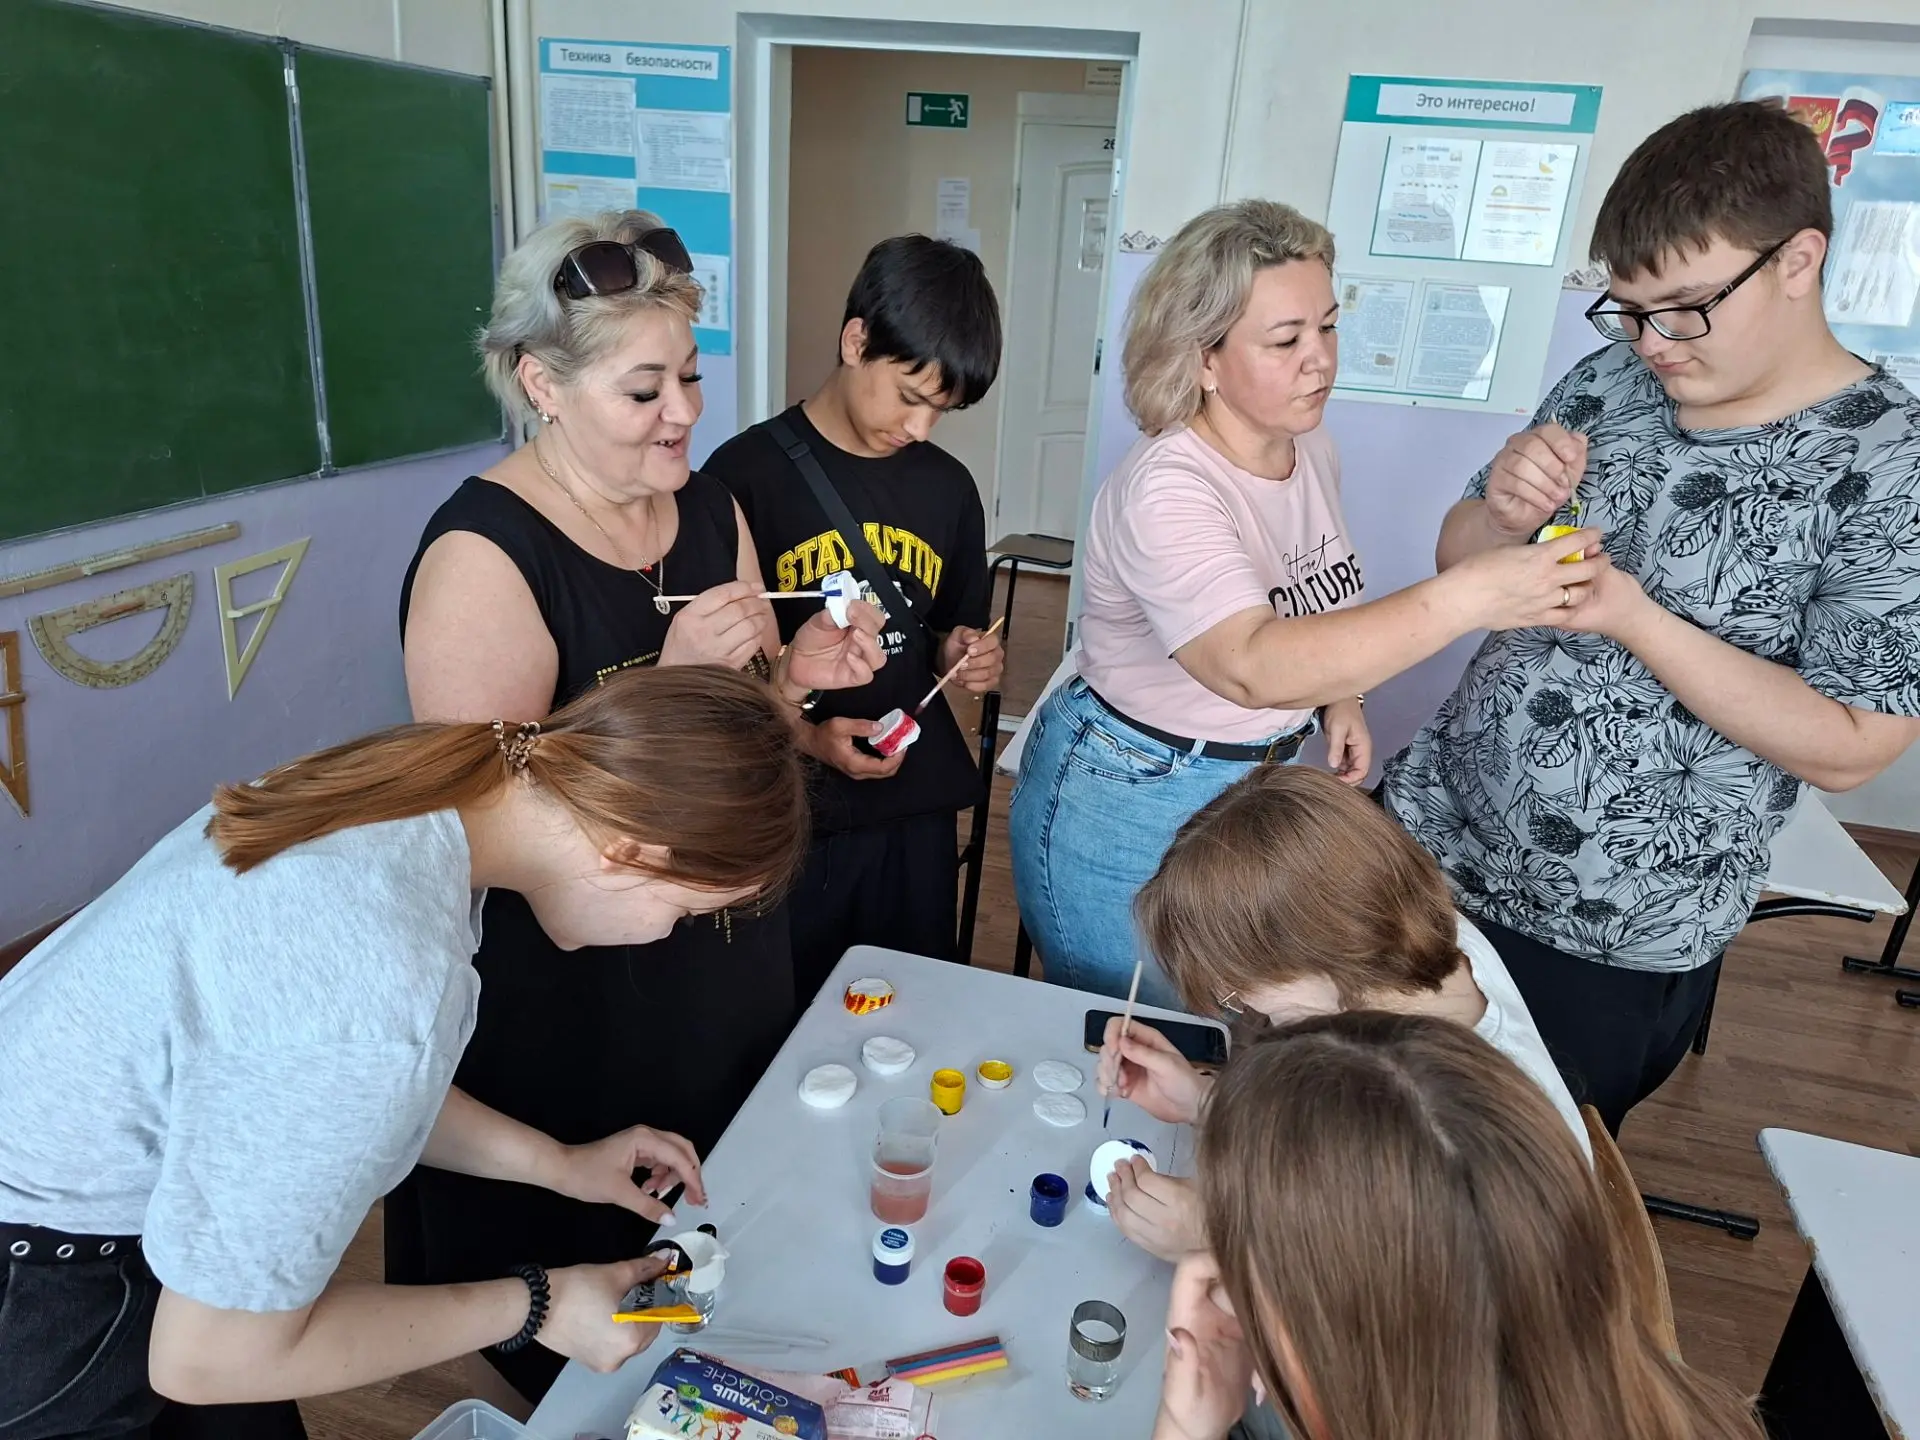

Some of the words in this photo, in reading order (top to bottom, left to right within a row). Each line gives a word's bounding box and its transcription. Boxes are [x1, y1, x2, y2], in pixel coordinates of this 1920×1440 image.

[560, 48, 611, 63] Техника
[626, 52, 712, 71] безопасности
[1416, 92, 1443, 108] Это
[1447, 97, 1536, 113] интересно!
[776, 529, 855, 593] STAY
[702, 1365, 789, 1408] GOUACHE
[712, 1383, 770, 1415] ГУАШЬ
